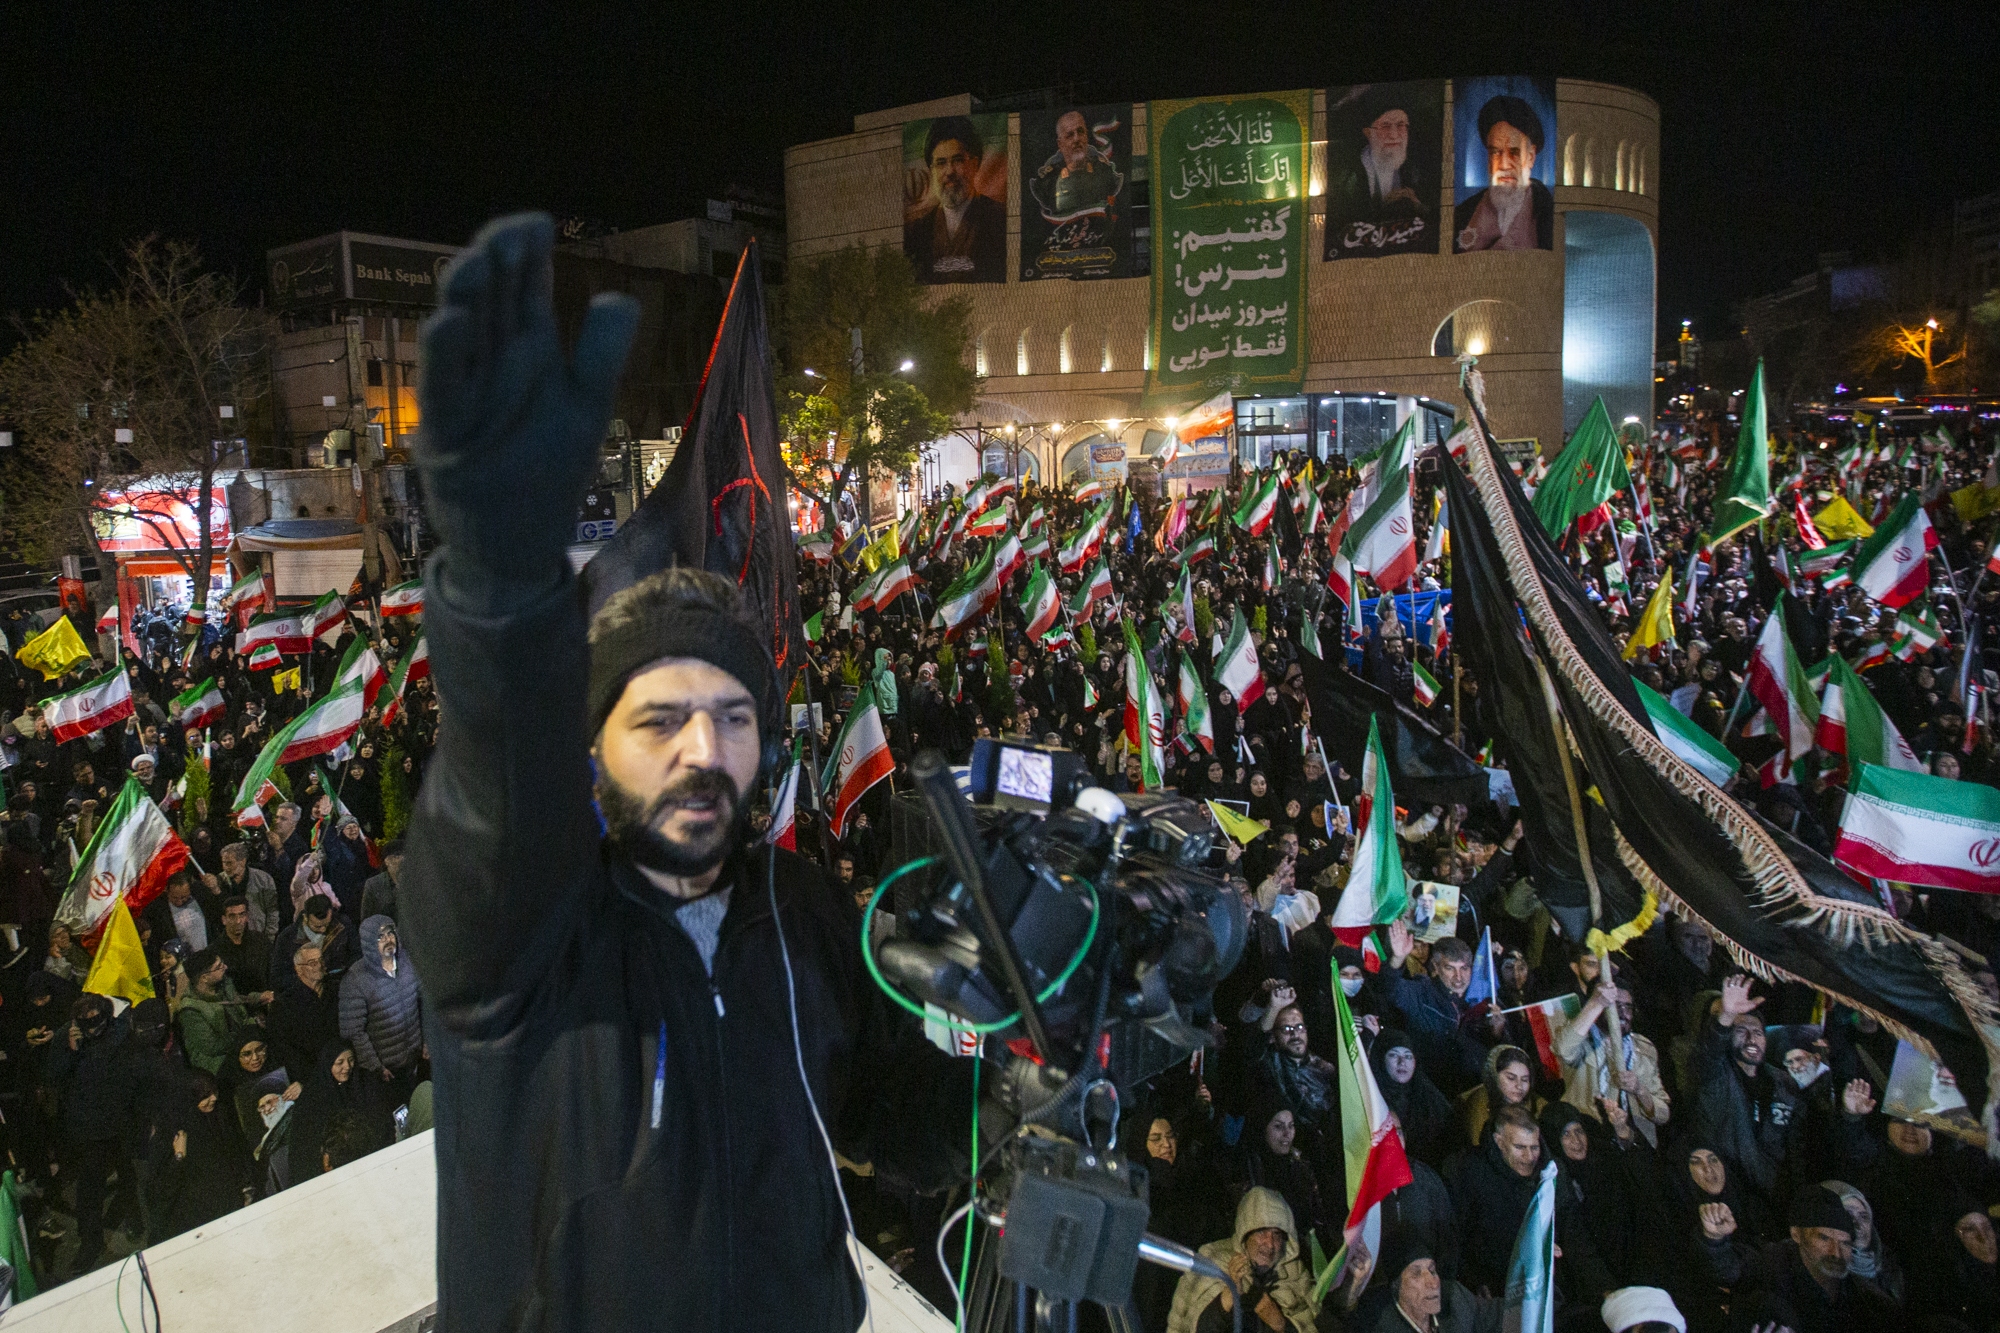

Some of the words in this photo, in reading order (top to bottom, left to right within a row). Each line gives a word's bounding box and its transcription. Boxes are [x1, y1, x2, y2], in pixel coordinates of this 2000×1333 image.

[1173, 205, 1291, 260] گفتیم:
[1343, 221, 1376, 249] حق
[1387, 216, 1425, 244] شهید
[355, 264, 392, 281] Bank
[395, 268, 432, 286] Sepah
[1175, 248, 1288, 297] نترس!
[1172, 302, 1231, 331] میدان
[1234, 300, 1287, 327] پیروز
[1169, 334, 1229, 372] تویی
[1232, 329, 1287, 357] فقط
